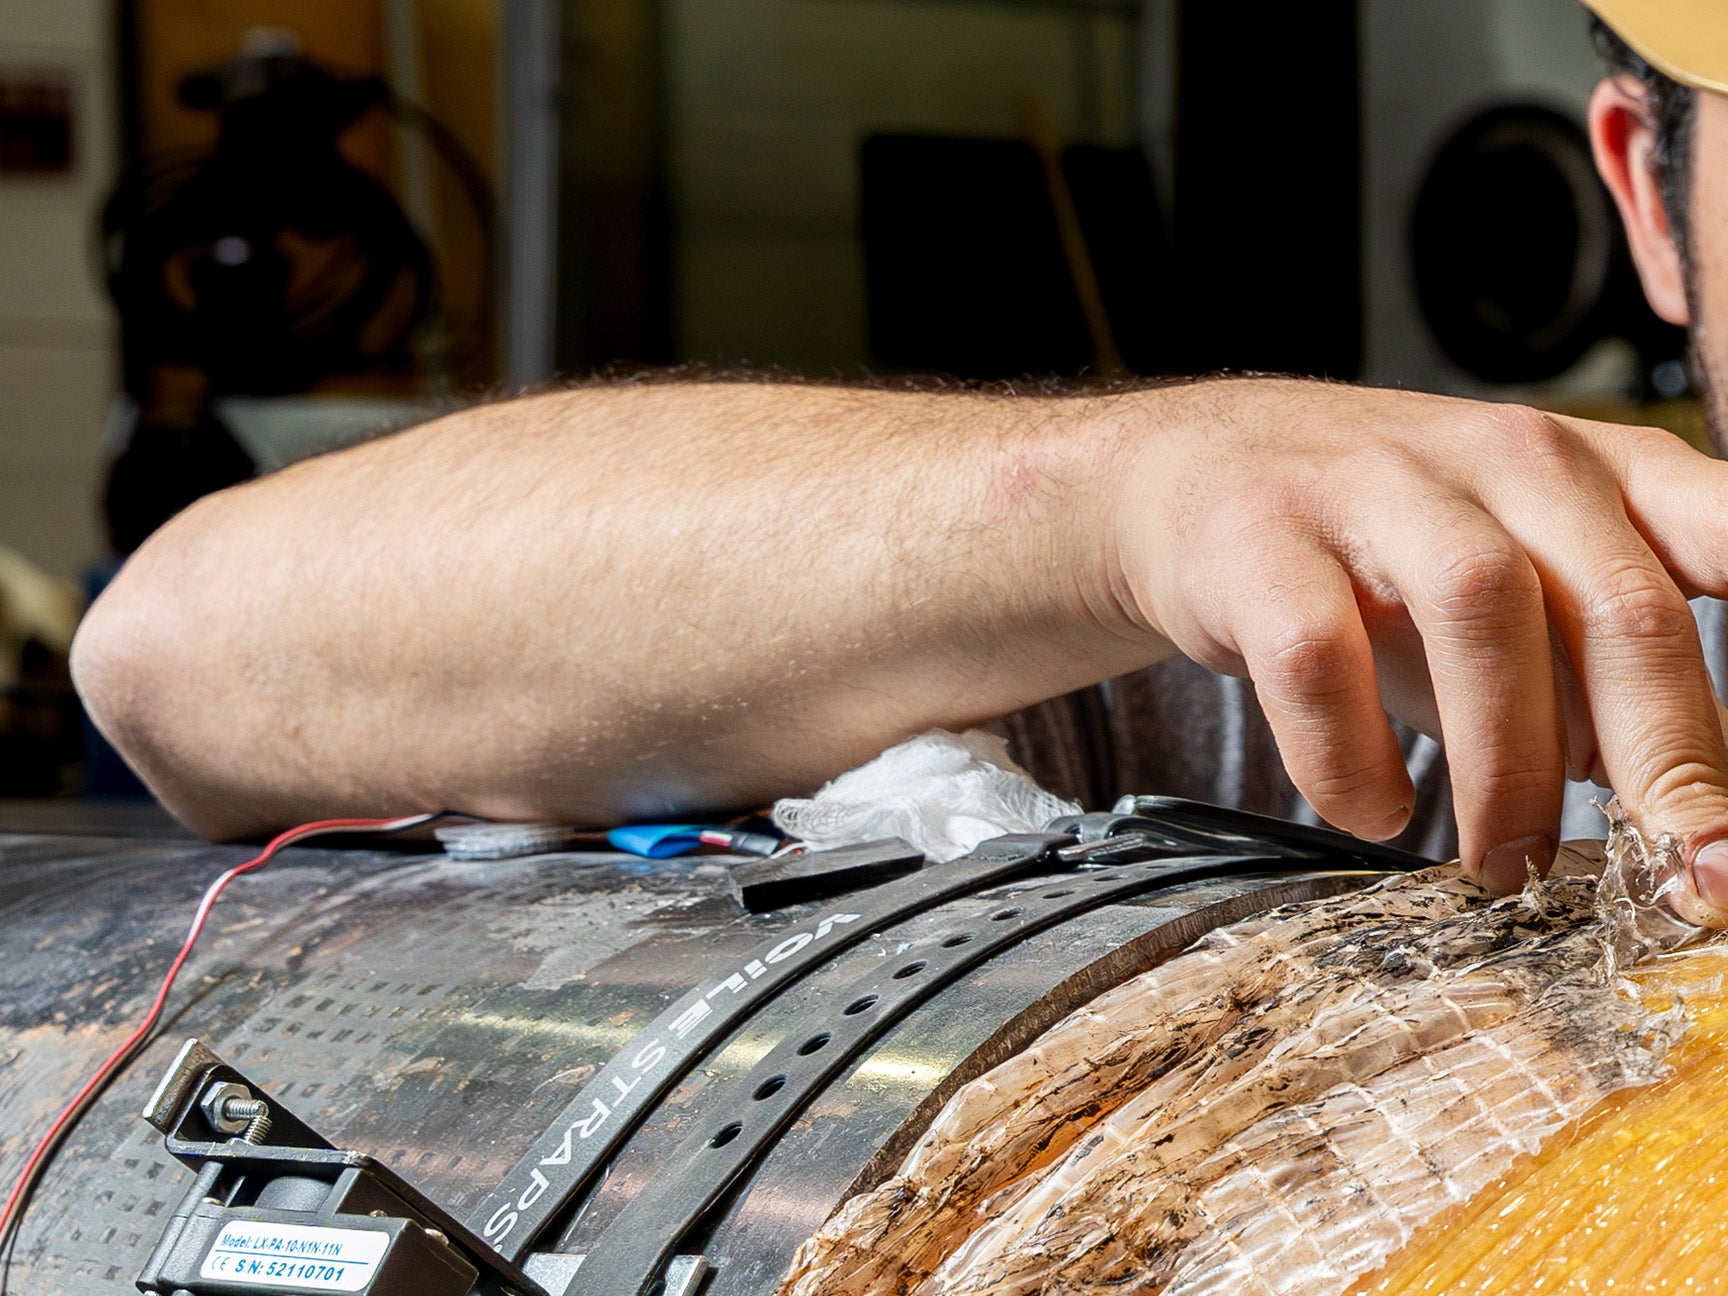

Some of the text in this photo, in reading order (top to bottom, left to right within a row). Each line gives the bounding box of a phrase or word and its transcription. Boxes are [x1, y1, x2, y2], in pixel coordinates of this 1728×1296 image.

[667, 910, 862, 1040] VOILE
[221, 1234, 344, 1256] Model: LX-PA-10-N1N-11N
[266, 1261, 346, 1281] 52110701
